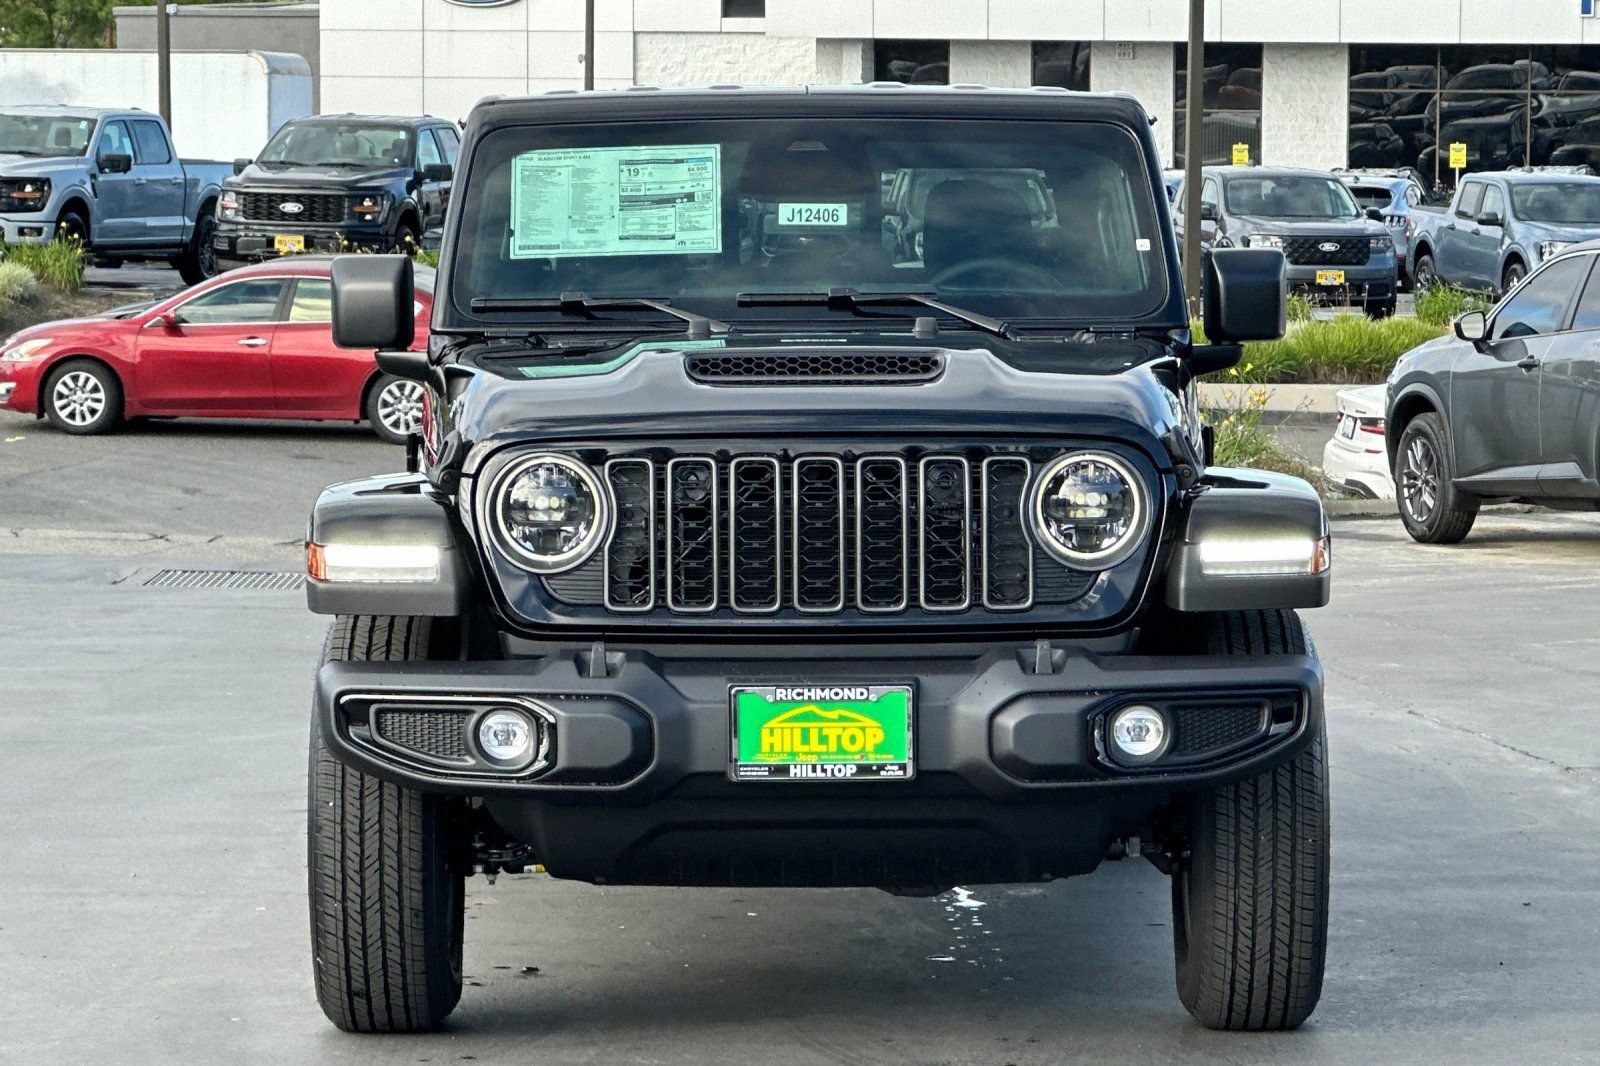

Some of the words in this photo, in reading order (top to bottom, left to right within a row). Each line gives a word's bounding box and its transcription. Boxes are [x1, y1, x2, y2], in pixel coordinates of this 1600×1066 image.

[627, 167, 640, 177] 19
[787, 208, 839, 223] J12406
[775, 688, 869, 701] RICHMOND
[761, 727, 885, 753] HILLTOP
[796, 752, 819, 762] Jeep
[789, 764, 857, 778] HILLTOP
